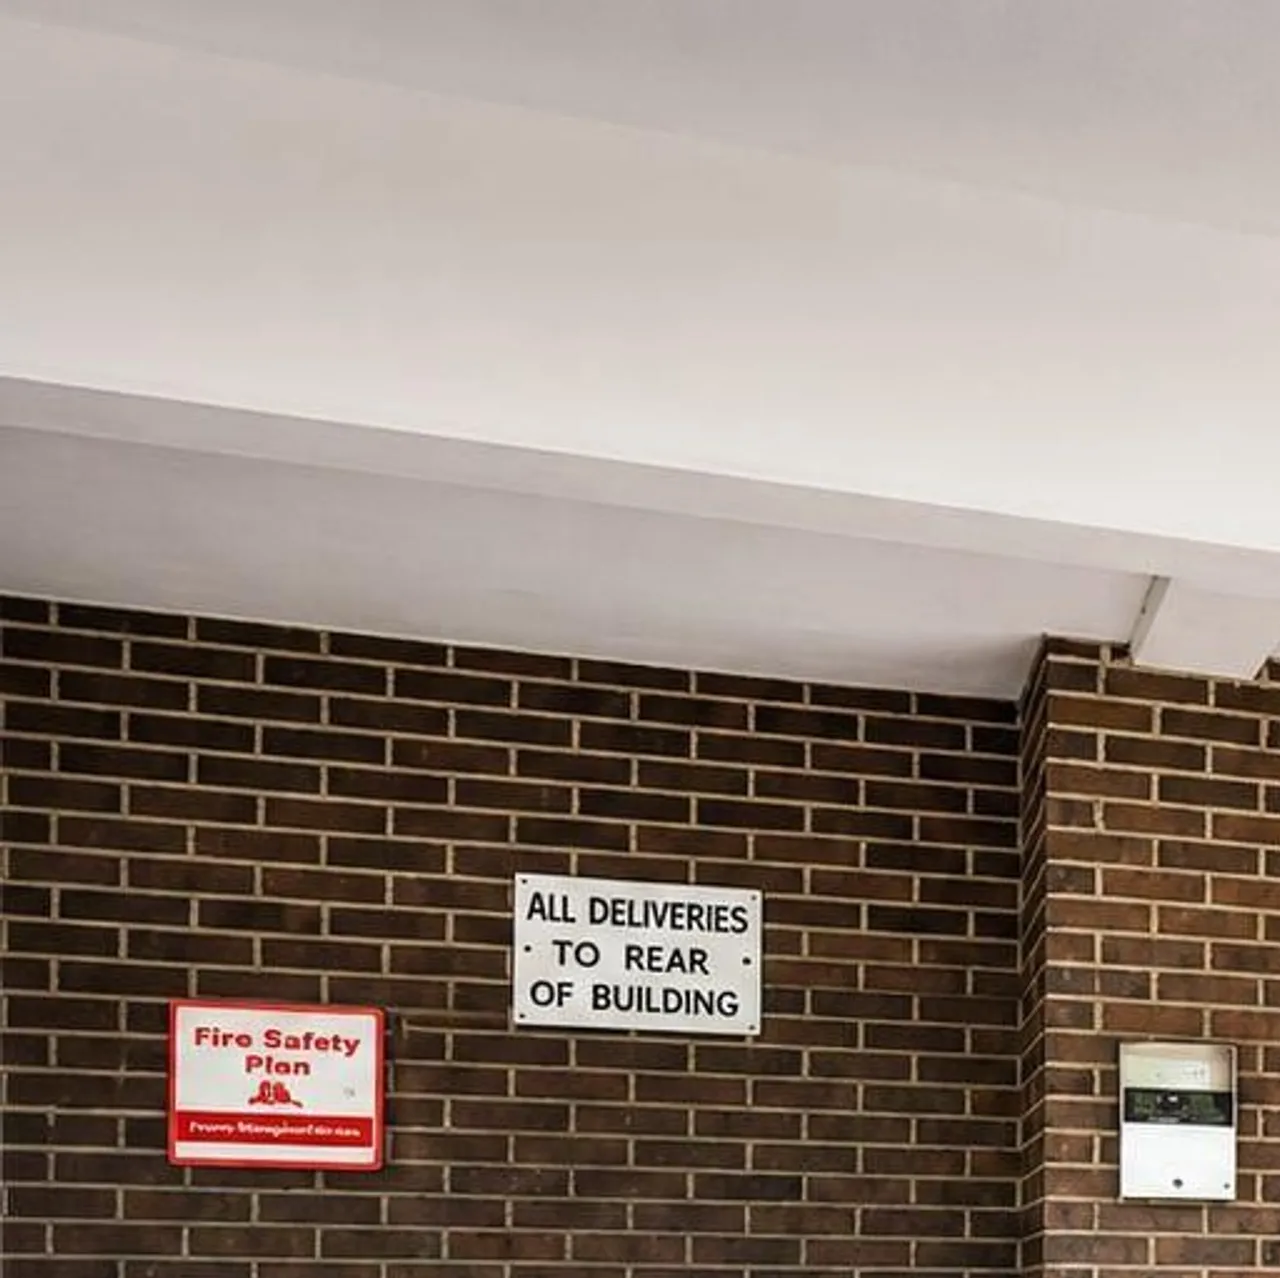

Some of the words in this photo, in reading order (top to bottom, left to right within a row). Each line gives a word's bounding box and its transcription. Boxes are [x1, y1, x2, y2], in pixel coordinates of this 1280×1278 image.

[526, 891, 576, 924] ALL
[589, 897, 749, 934] DELIVERIES
[552, 940, 601, 968] TO
[624, 944, 710, 976] REAR
[529, 980, 574, 1008] OF
[591, 984, 739, 1018] BUILDING
[195, 1026, 253, 1048] Fire
[263, 1029, 361, 1057] Safety
[245, 1055, 311, 1076] Plan
